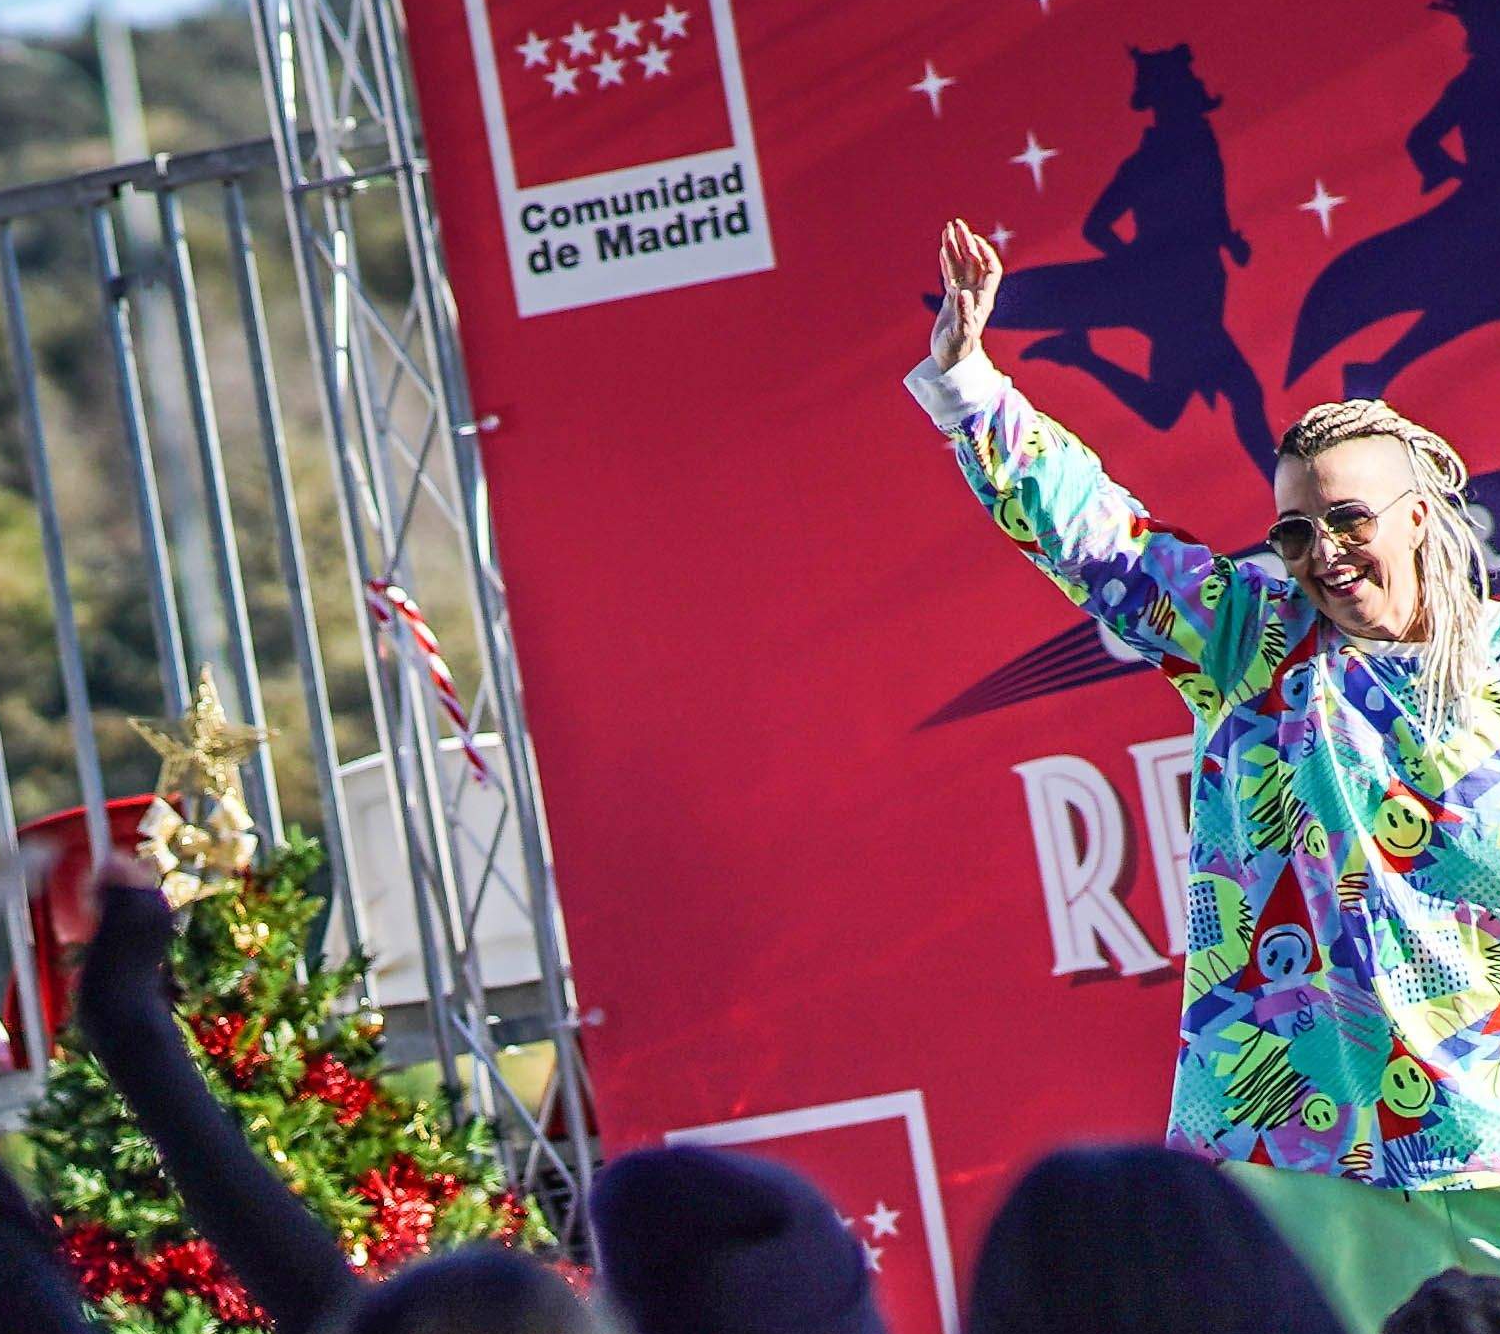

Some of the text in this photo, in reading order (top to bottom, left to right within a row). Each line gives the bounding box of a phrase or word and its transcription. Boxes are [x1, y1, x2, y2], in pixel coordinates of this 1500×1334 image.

[519, 163, 746, 235] Comunidad
[526, 200, 752, 276] de Madrid
